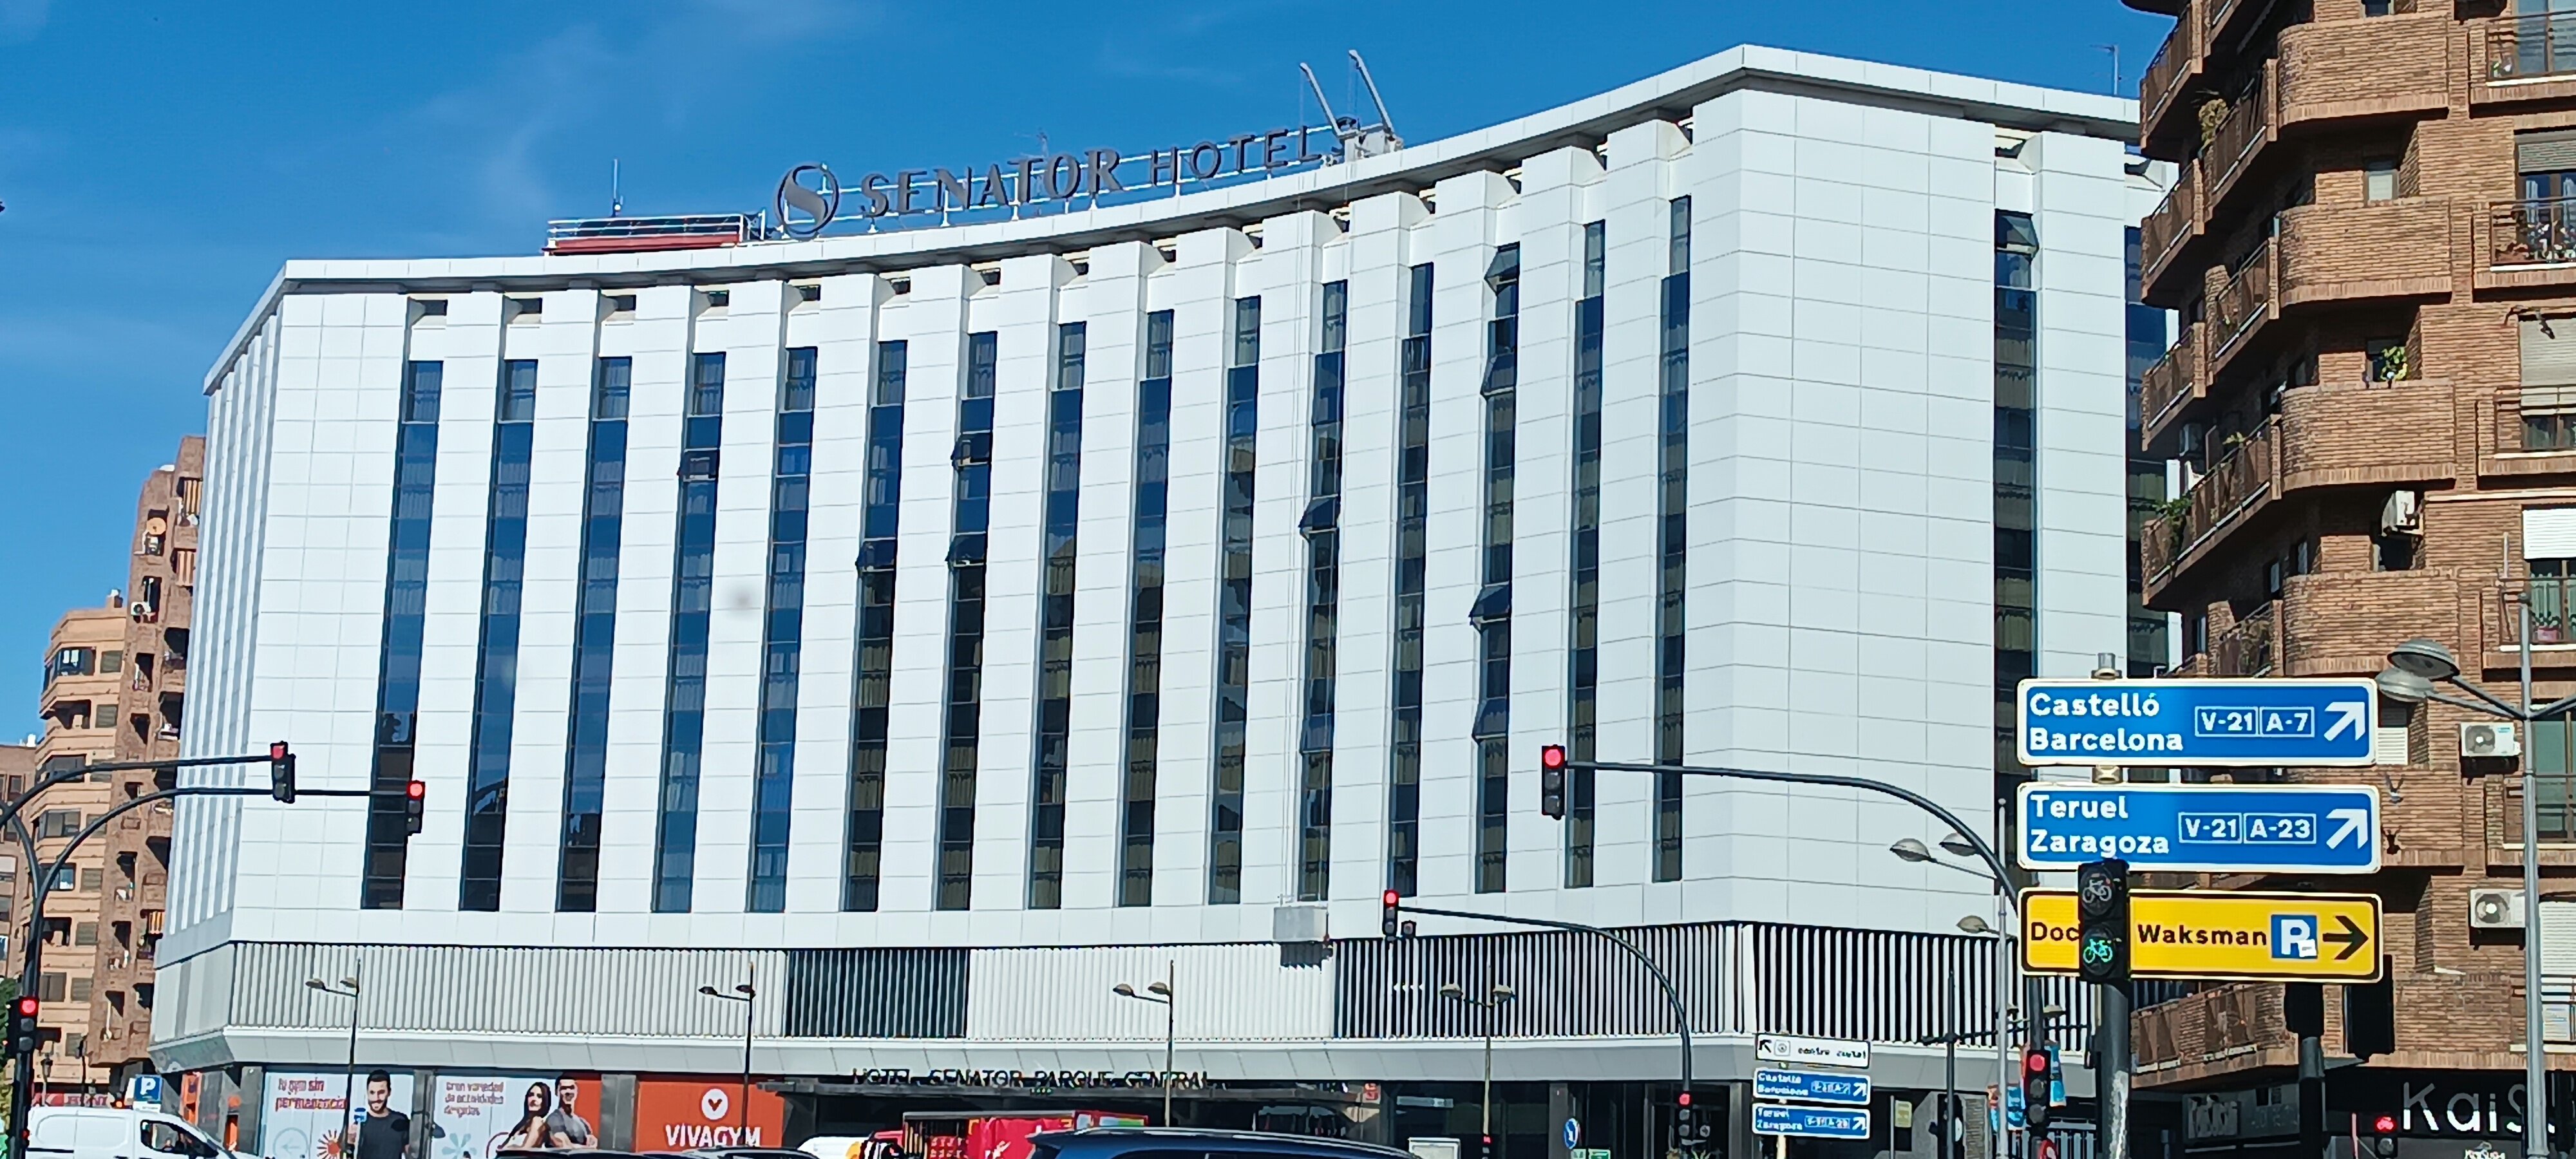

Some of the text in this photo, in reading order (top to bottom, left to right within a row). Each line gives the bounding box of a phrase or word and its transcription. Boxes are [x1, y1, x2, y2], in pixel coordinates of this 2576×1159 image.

[860, 148, 1123, 218] SENATOR
[2030, 692, 2160, 717] Castelló
[2201, 711, 2309, 731] V-21 A-7
[2030, 727, 2184, 751] Barcelona
[2030, 794, 2129, 819] Teruel
[2184, 818, 2311, 840] V-21 A-23
[2030, 829, 2170, 859] Zaragoza
[2031, 921, 2081, 942] Doc
[2137, 923, 2268, 946] Waksman
[665, 1123, 761, 1147] VIVAGYM
